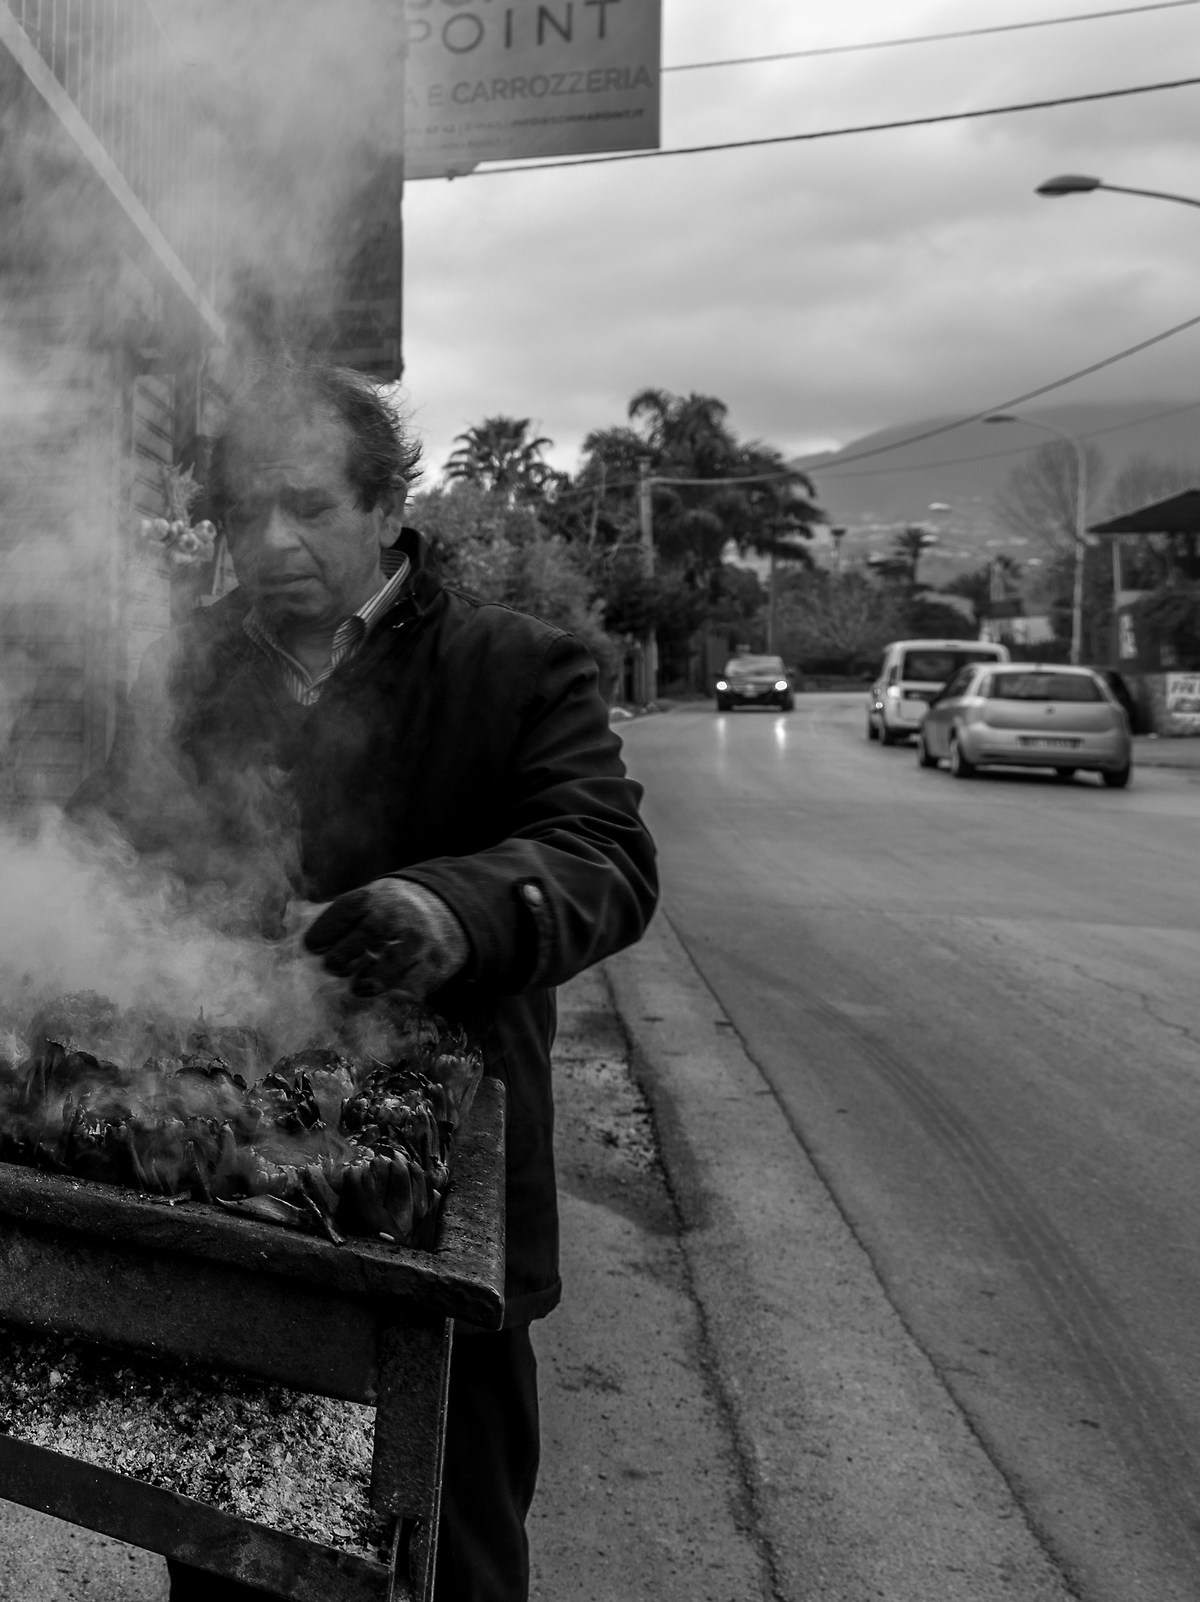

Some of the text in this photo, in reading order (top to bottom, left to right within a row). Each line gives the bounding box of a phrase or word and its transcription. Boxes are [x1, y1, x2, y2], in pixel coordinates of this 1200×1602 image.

[405, 0, 621, 54] POINT
[427, 83, 444, 107] E
[451, 64, 653, 105] CARROZZERIA
